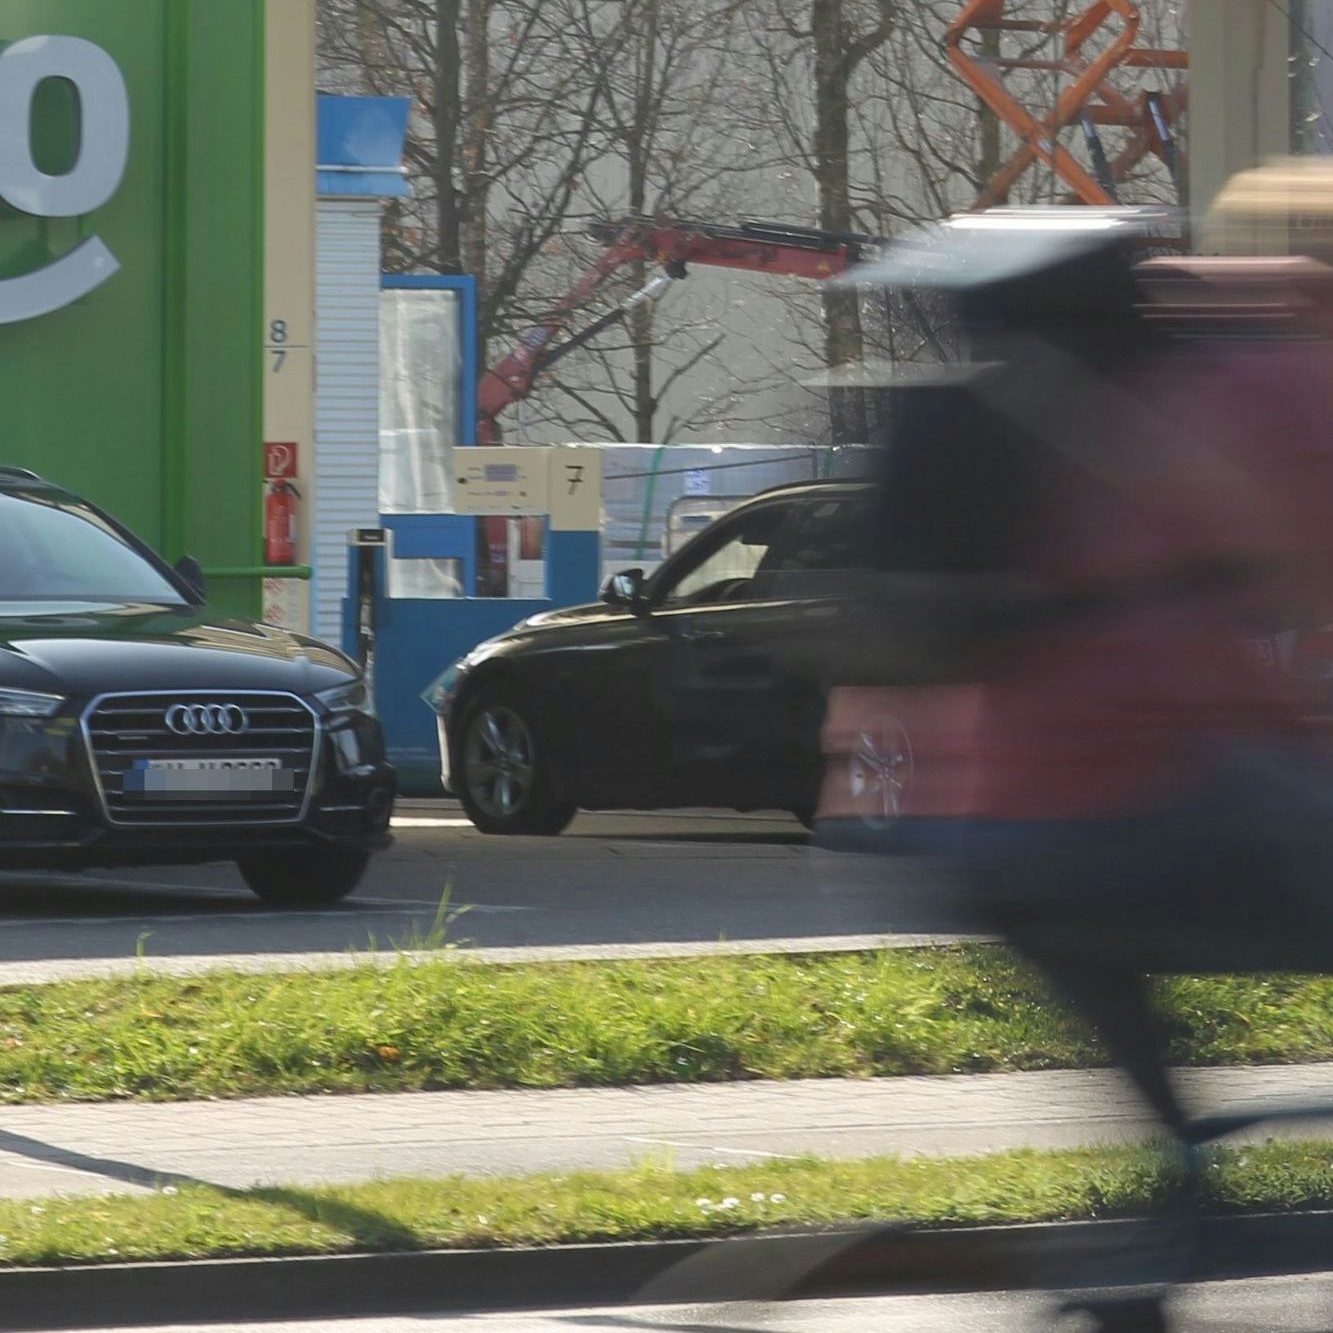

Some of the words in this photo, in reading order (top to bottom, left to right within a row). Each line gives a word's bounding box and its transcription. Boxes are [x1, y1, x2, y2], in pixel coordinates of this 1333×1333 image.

[269, 318, 288, 344] 8
[271, 350, 288, 374] 7
[565, 464, 585, 496] 7
